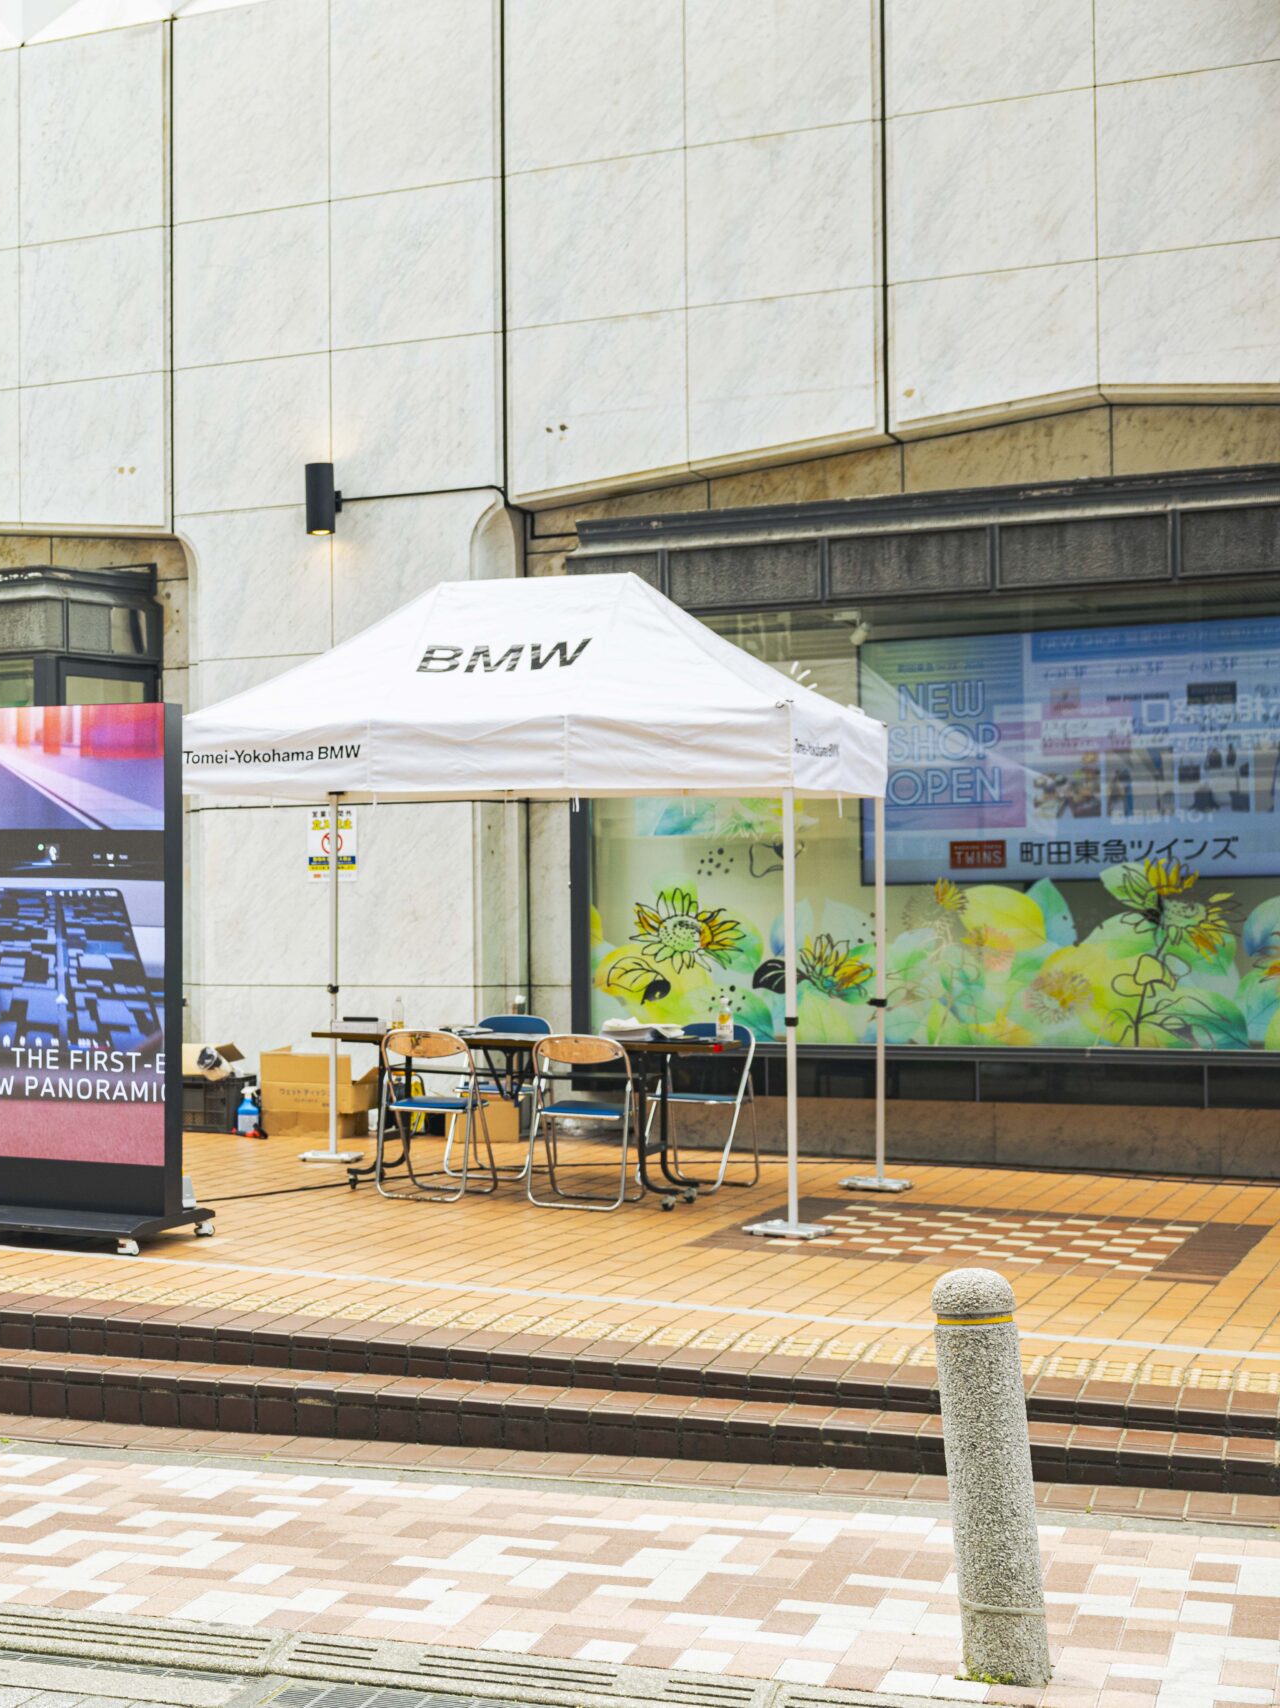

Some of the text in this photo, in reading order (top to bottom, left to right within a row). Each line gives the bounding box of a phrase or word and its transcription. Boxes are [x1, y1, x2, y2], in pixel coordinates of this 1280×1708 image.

[416, 638, 593, 674] BMW
[897, 679, 986, 722] NEW
[183, 744, 361, 765] Tomei-Yokohama BMW
[888, 721, 1002, 763] SHOP
[886, 766, 1003, 806] OPEN
[954, 850, 1003, 865] TWINS
[1020, 835, 1240, 866] 町田東急ツインズ
[11, 1047, 60, 1070] THE
